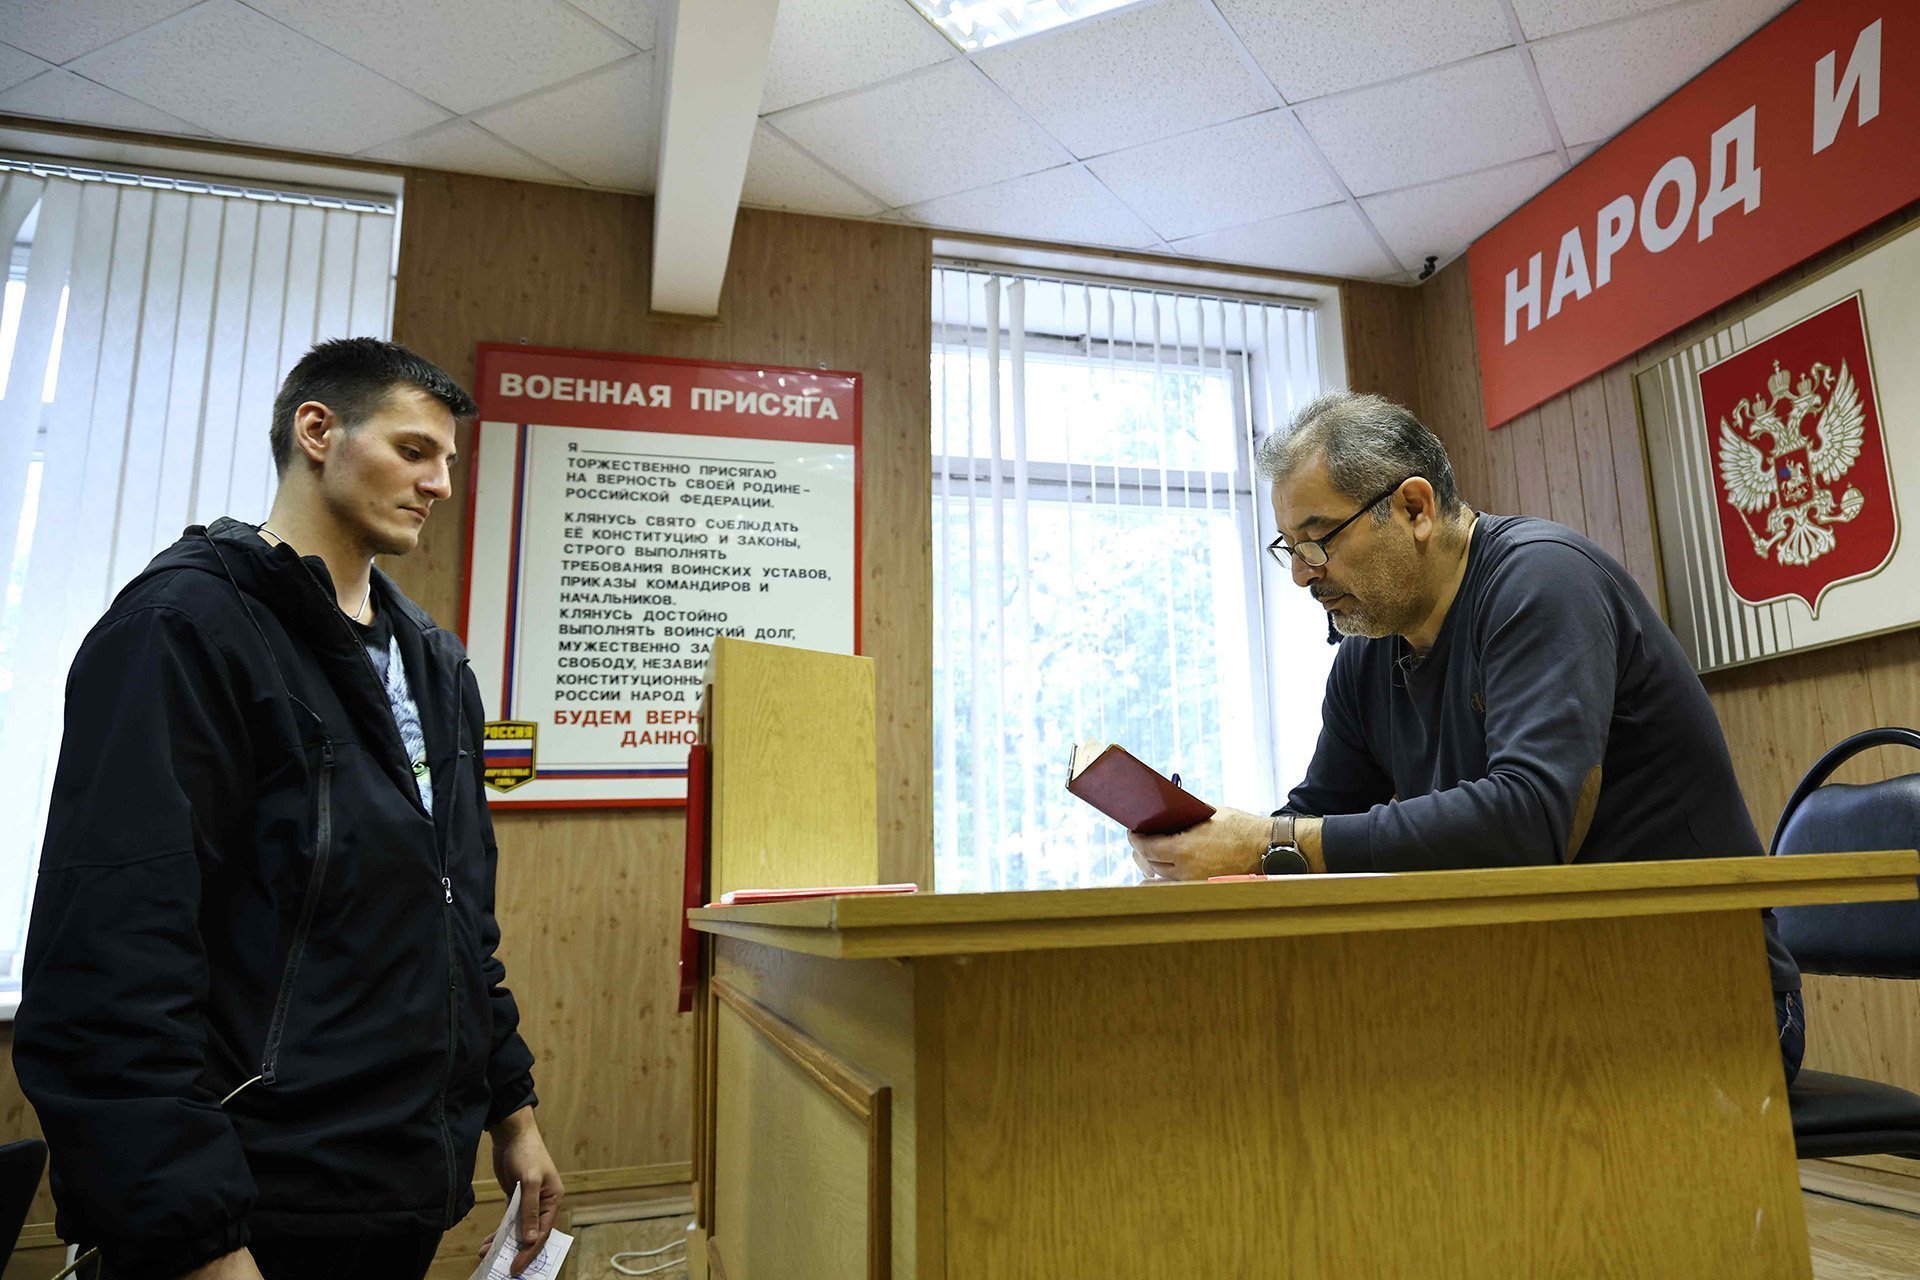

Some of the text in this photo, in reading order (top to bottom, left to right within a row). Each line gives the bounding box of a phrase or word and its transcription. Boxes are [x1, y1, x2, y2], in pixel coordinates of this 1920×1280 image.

[1504, 17, 1882, 346] НАРОД И
[500, 373, 838, 420] ВОЕННАЯ ПРИСЯГА
[568, 442, 577, 452] Я
[567, 457, 776, 480] ТОРЖЕСТВЕННО ПРИСЯГАЮ
[567, 473, 586, 482] НА
[596, 474, 676, 488] ВЕРНОСТЬ
[686, 479, 734, 490] СВОЕЙ
[565, 487, 776, 508] РОССИЙСКОЙ ФЕДЕРАЦИИ.
[565, 512, 636, 526] КЛЯНУСЬ
[646, 516, 696, 528] СВЯТО
[592, 529, 707, 545] КОНСТИТУЦИЮ
[719, 535, 728, 544] И
[738, 535, 800, 549] ЗАКОНЫ,
[563, 544, 726, 559] СТРОГО ВЫПОЛНЯТЬ
[561, 560, 831, 580] ТРЕБОВАНИЯ ВОИНСКИХ УСТАВОВ,
[561, 576, 768, 594] ПРИКАЗЫ КОМАНДИРОВ И
[560, 593, 675, 607] НАЧАЛЬНИКОВ.
[560, 609, 727, 622] КЛЯНУСЬ ДОСТОЙНО
[559, 624, 795, 641] ВЫПОЛНЯТЬ ВОИНСКИЙ ДОЛГ,
[559, 641, 710, 654] МУЖЕСТВЕННО ЗА
[558, 657, 708, 670] СВОБОДУ, НЕЗАВИ
[555, 690, 620, 701] РОССИИ
[631, 691, 684, 701] НАРОД
[554, 710, 700, 727] БУДЕМ ВЕРН
[621, 730, 698, 748] ДАННО
